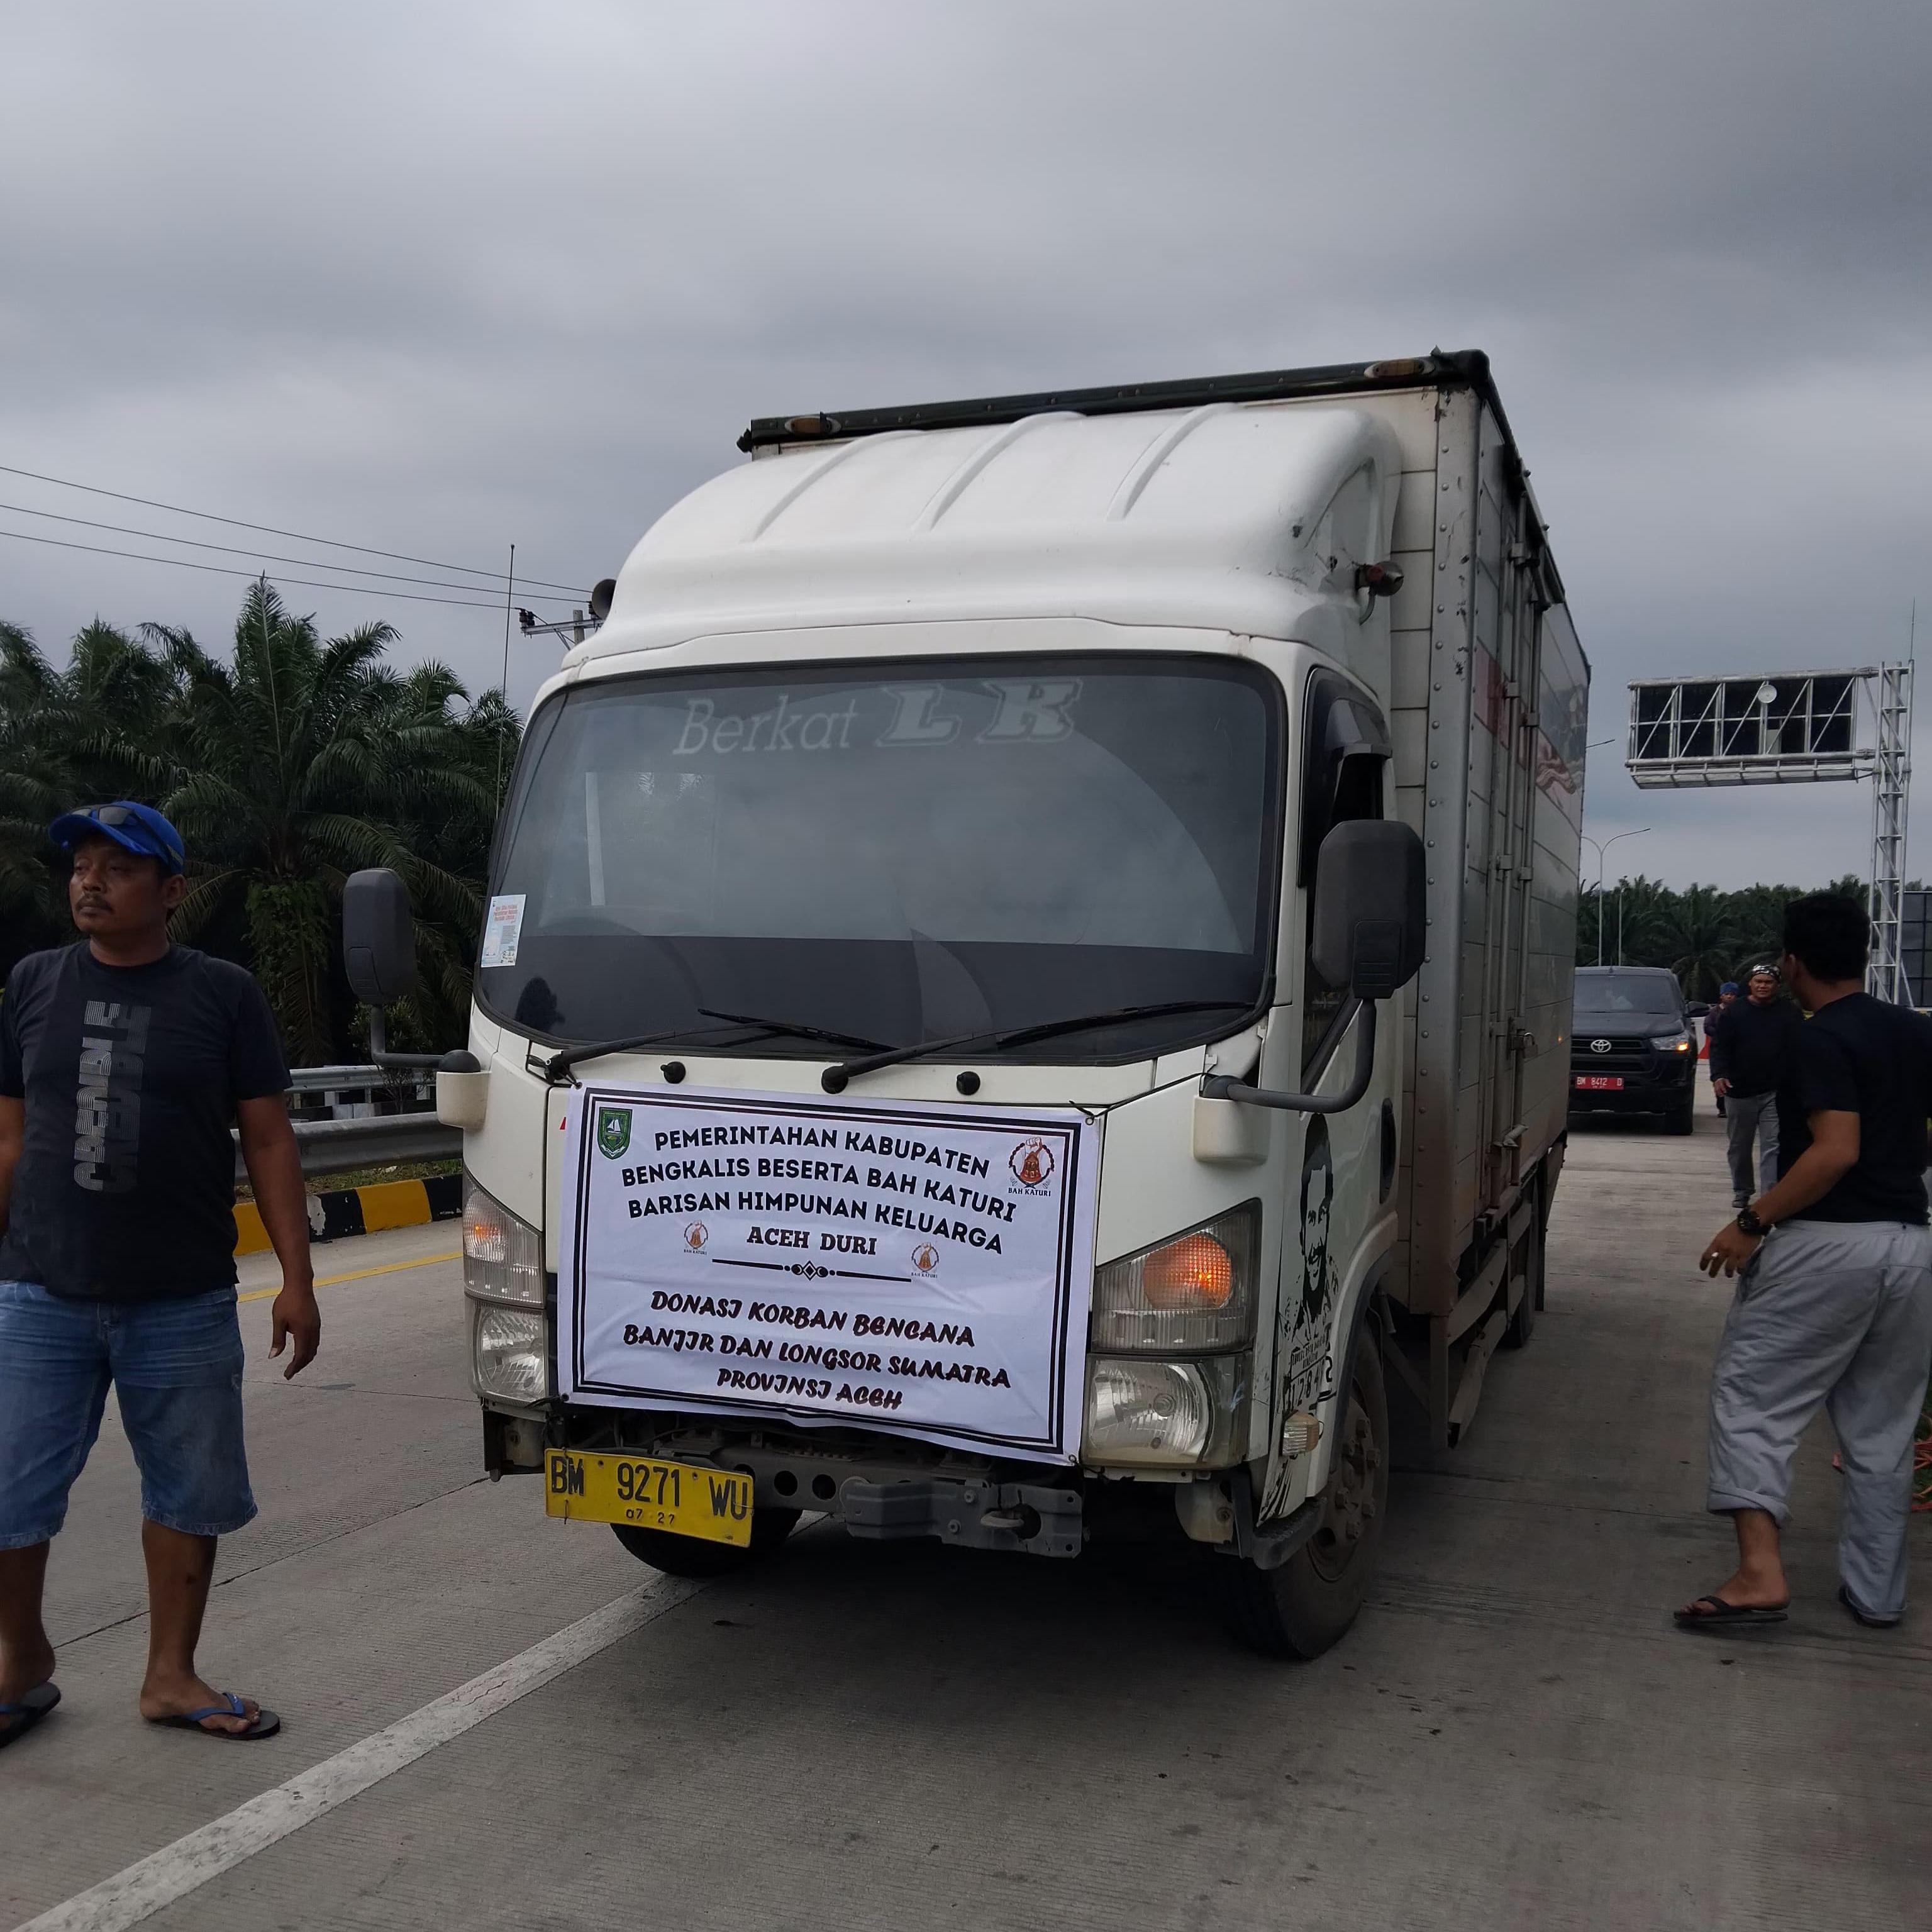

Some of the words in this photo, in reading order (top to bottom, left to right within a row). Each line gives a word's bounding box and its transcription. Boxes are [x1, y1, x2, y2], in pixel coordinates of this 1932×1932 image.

[672, 693, 859, 755] Berkat
[1591, 1077, 1607, 1085] 8412
[655, 1126, 838, 1151] PEMERINTAHAN
[845, 1131, 990, 1179] KABUPATEN
[621, 1158, 750, 1187] BENGKALIS
[757, 1158, 860, 1185] BESERTA
[867, 1167, 917, 1195] BAH
[923, 1178, 1017, 1223] KATURI
[1024, 1189, 1051, 1197] KATURI
[628, 1192, 730, 1219] BARISAN
[738, 1192, 867, 1220] HIMPUNAN
[875, 1203, 1002, 1255] KELUARGA
[747, 1226, 810, 1249] ACEH
[819, 1233, 877, 1255] DURI
[748, 1301, 848, 1331] KORBAN
[852, 1313, 975, 1347] BENCANA
[719, 1335, 774, 1358] DAN
[779, 1341, 882, 1373] LONGSOR
[887, 1355, 1011, 1389] SUMATRA
[835, 1382, 903, 1410] ACEH
[550, 1455, 584, 1496] BM
[617, 1462, 680, 1507] 9271
[708, 1475, 748, 1521] WU
